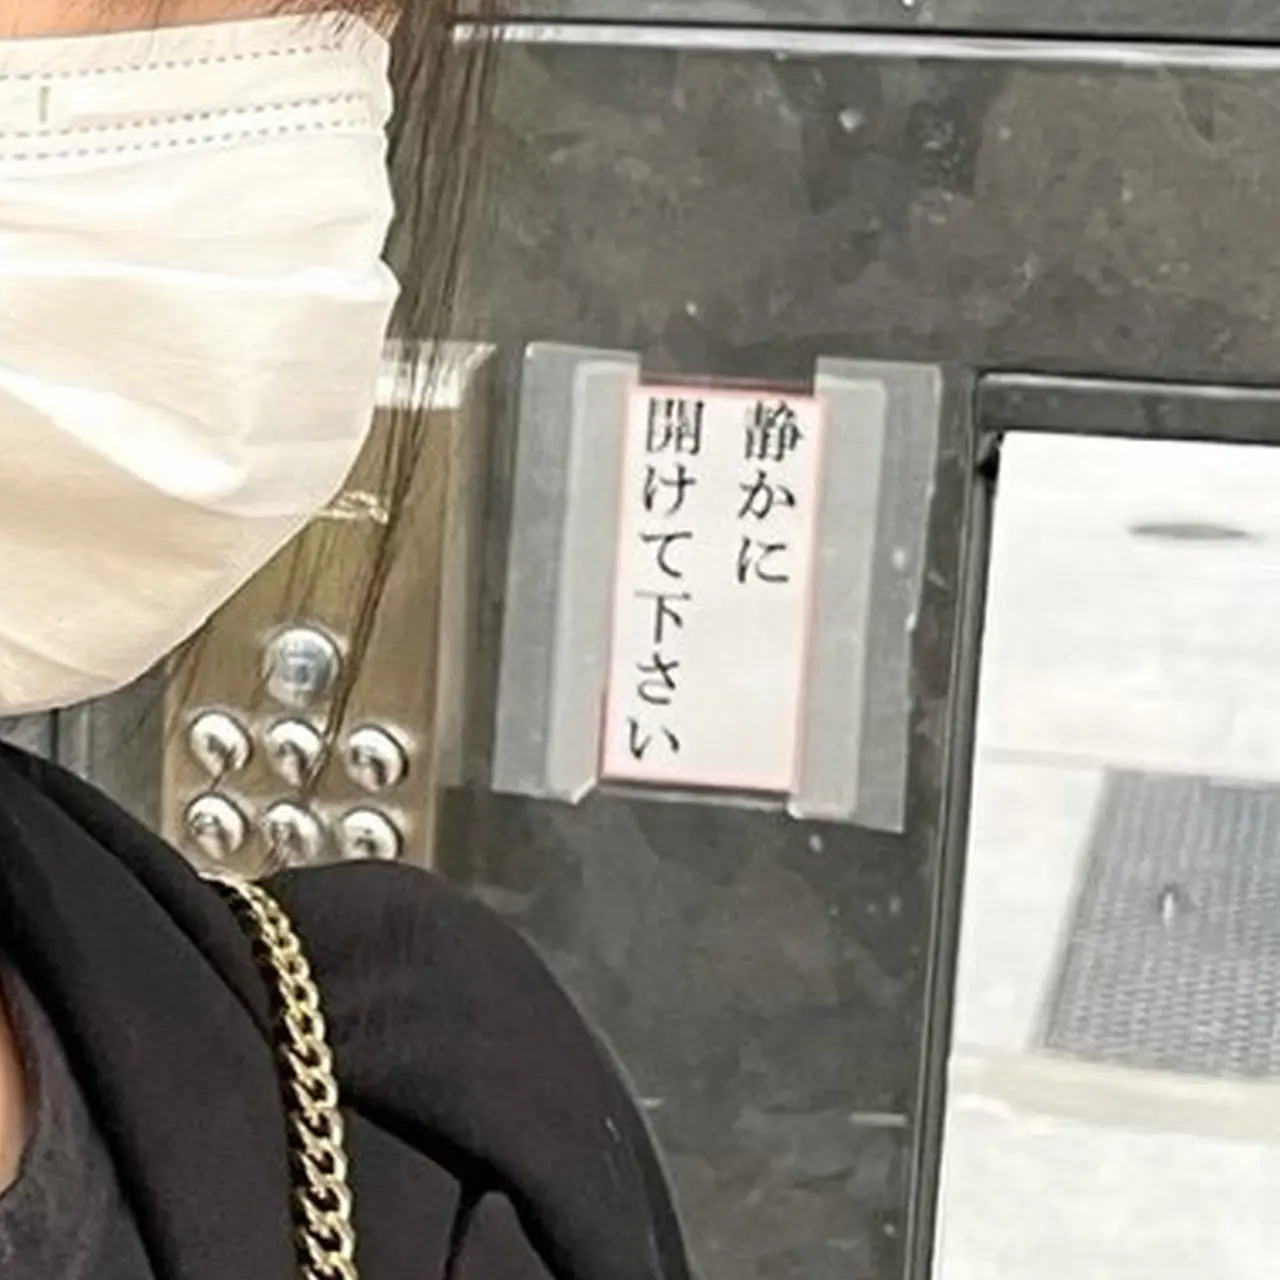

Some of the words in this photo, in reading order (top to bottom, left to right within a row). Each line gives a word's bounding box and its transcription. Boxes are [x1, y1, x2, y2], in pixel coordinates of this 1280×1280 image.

[627, 397, 706, 760] 開けて下さい
[737, 400, 804, 584] 静かに
